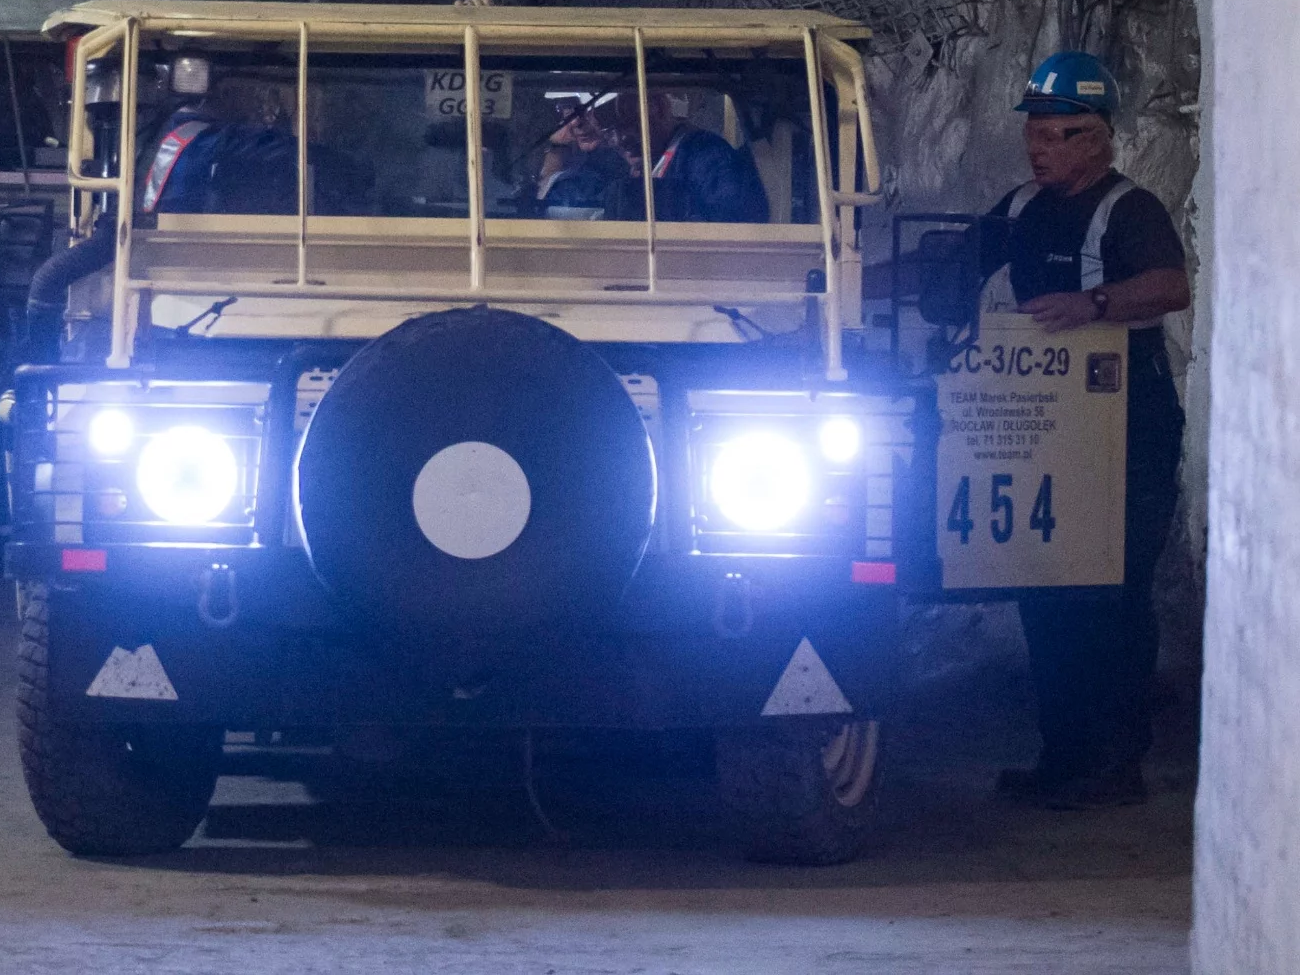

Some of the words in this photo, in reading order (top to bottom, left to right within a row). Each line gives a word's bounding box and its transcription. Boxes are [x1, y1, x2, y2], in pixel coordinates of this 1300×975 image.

[430, 72, 504, 92] KDG
[950, 392, 977, 403] TEAM
[980, 392, 1007, 403] Marek
